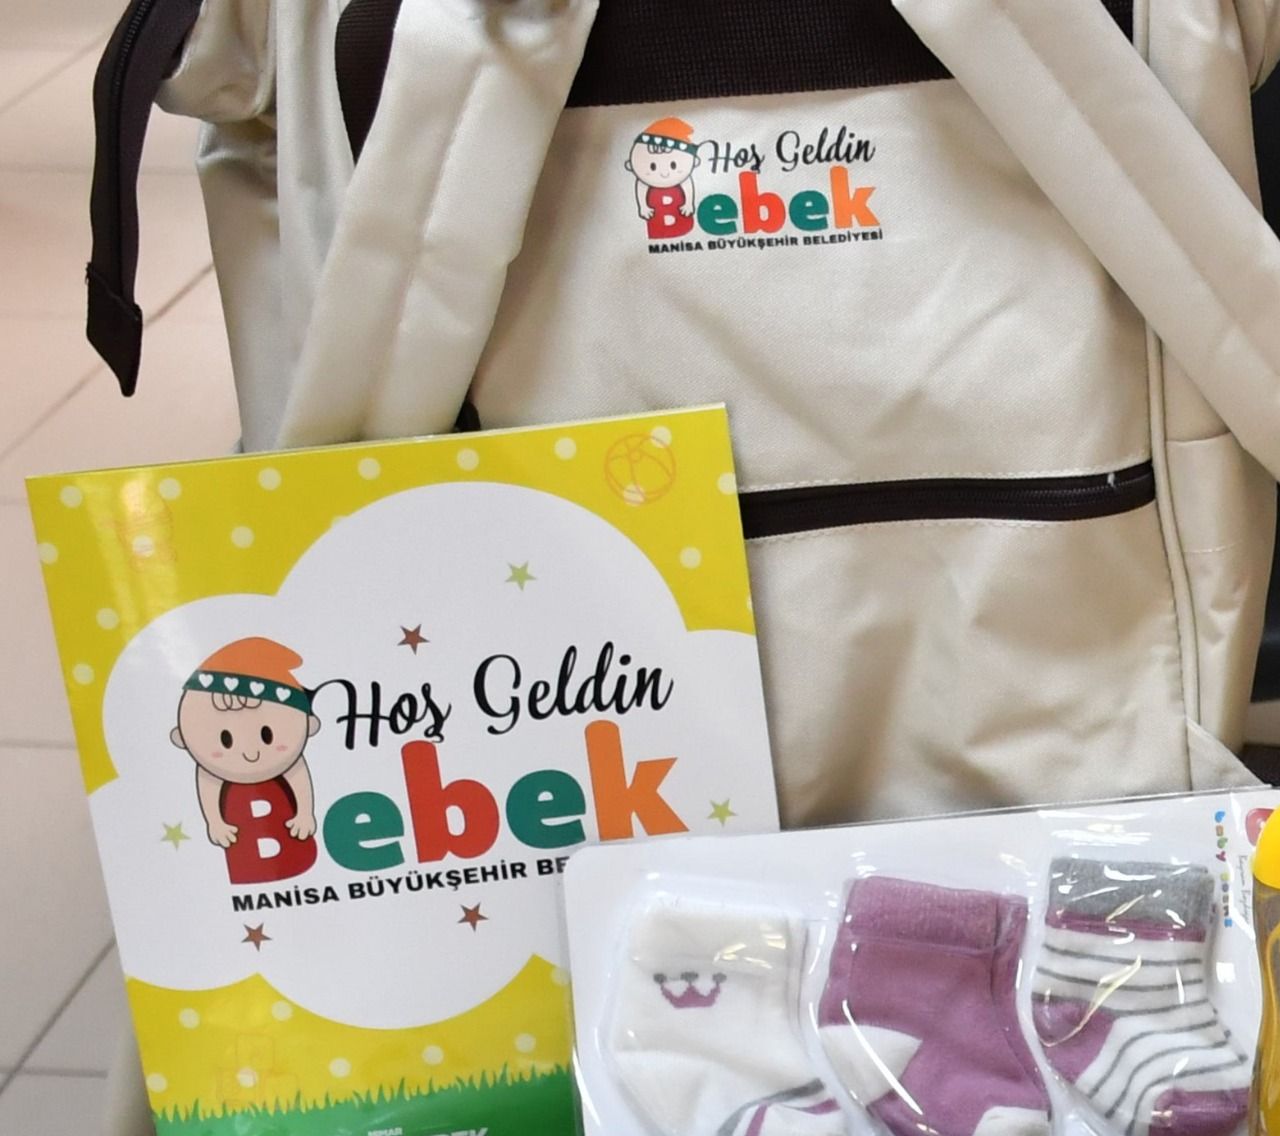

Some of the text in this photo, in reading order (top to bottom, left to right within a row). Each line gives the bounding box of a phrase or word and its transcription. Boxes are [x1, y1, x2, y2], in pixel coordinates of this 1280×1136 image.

[697, 126, 876, 174] Hoş Geldin
[646, 165, 881, 239] Bebek
[649, 228, 883, 255] MANİSA BÜYÜKŞEHİR BELEDİYESİ
[310, 640, 674, 750] Hoş Geldin
[219, 720, 690, 886] Bebek
[231, 884, 340, 912] MANİSA
[348, 859, 528, 900] BÜYÜKŞEHİR
